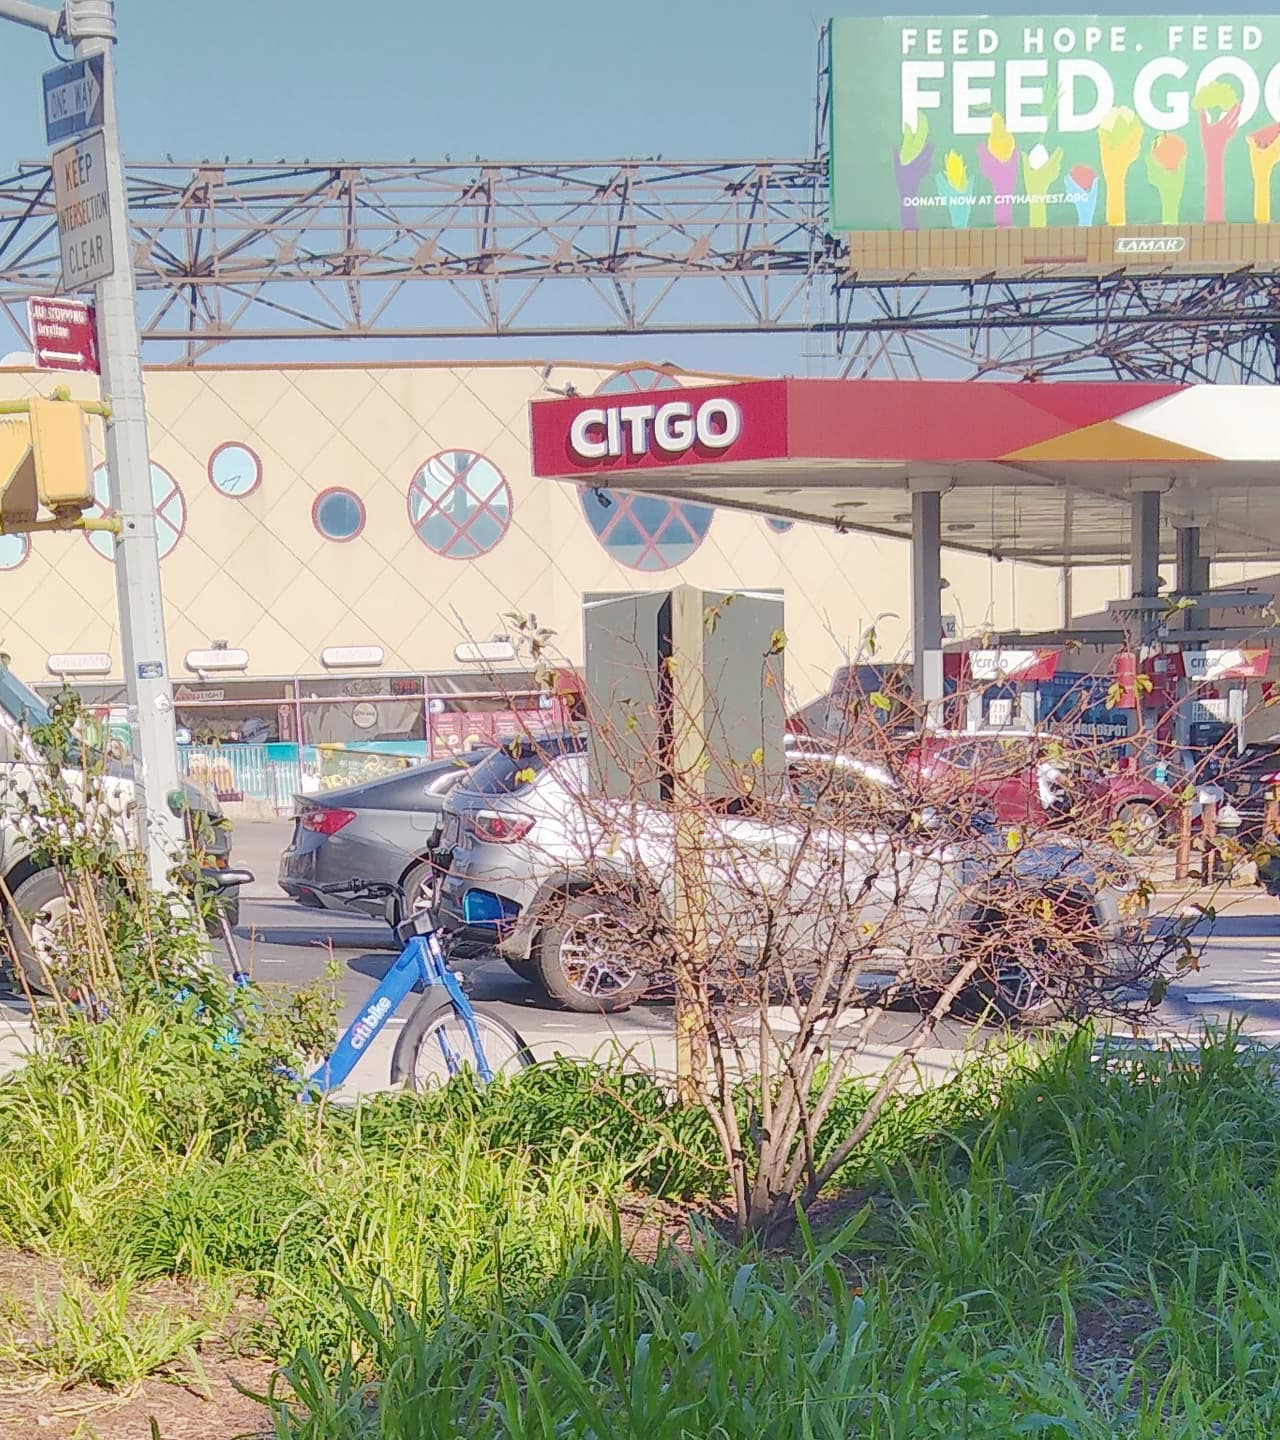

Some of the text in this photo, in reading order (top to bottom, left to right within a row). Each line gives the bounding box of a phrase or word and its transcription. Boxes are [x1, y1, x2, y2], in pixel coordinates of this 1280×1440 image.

[901, 28, 999, 54] FEED
[1023, 27, 1143, 52] HOPE.
[1169, 26, 1263, 50] FEED
[51, 78, 94, 119] ONE WAY
[901, 59, 1114, 134] FEED
[64, 153, 93, 193] KEEP
[60, 190, 108, 237] INTERSECTION
[903, 193, 1089, 207] DONATE NOW AT CITYHARVEST.ORG
[69, 235, 104, 274] CLEAR
[48, 306, 87, 326] STOPPING
[570, 398, 742, 458] CITGO
[946, 621, 955, 633] 12
[976, 657, 1008, 670] CITGO
[1191, 656, 1219, 669] CITGO
[361, 996, 392, 1030] bike
